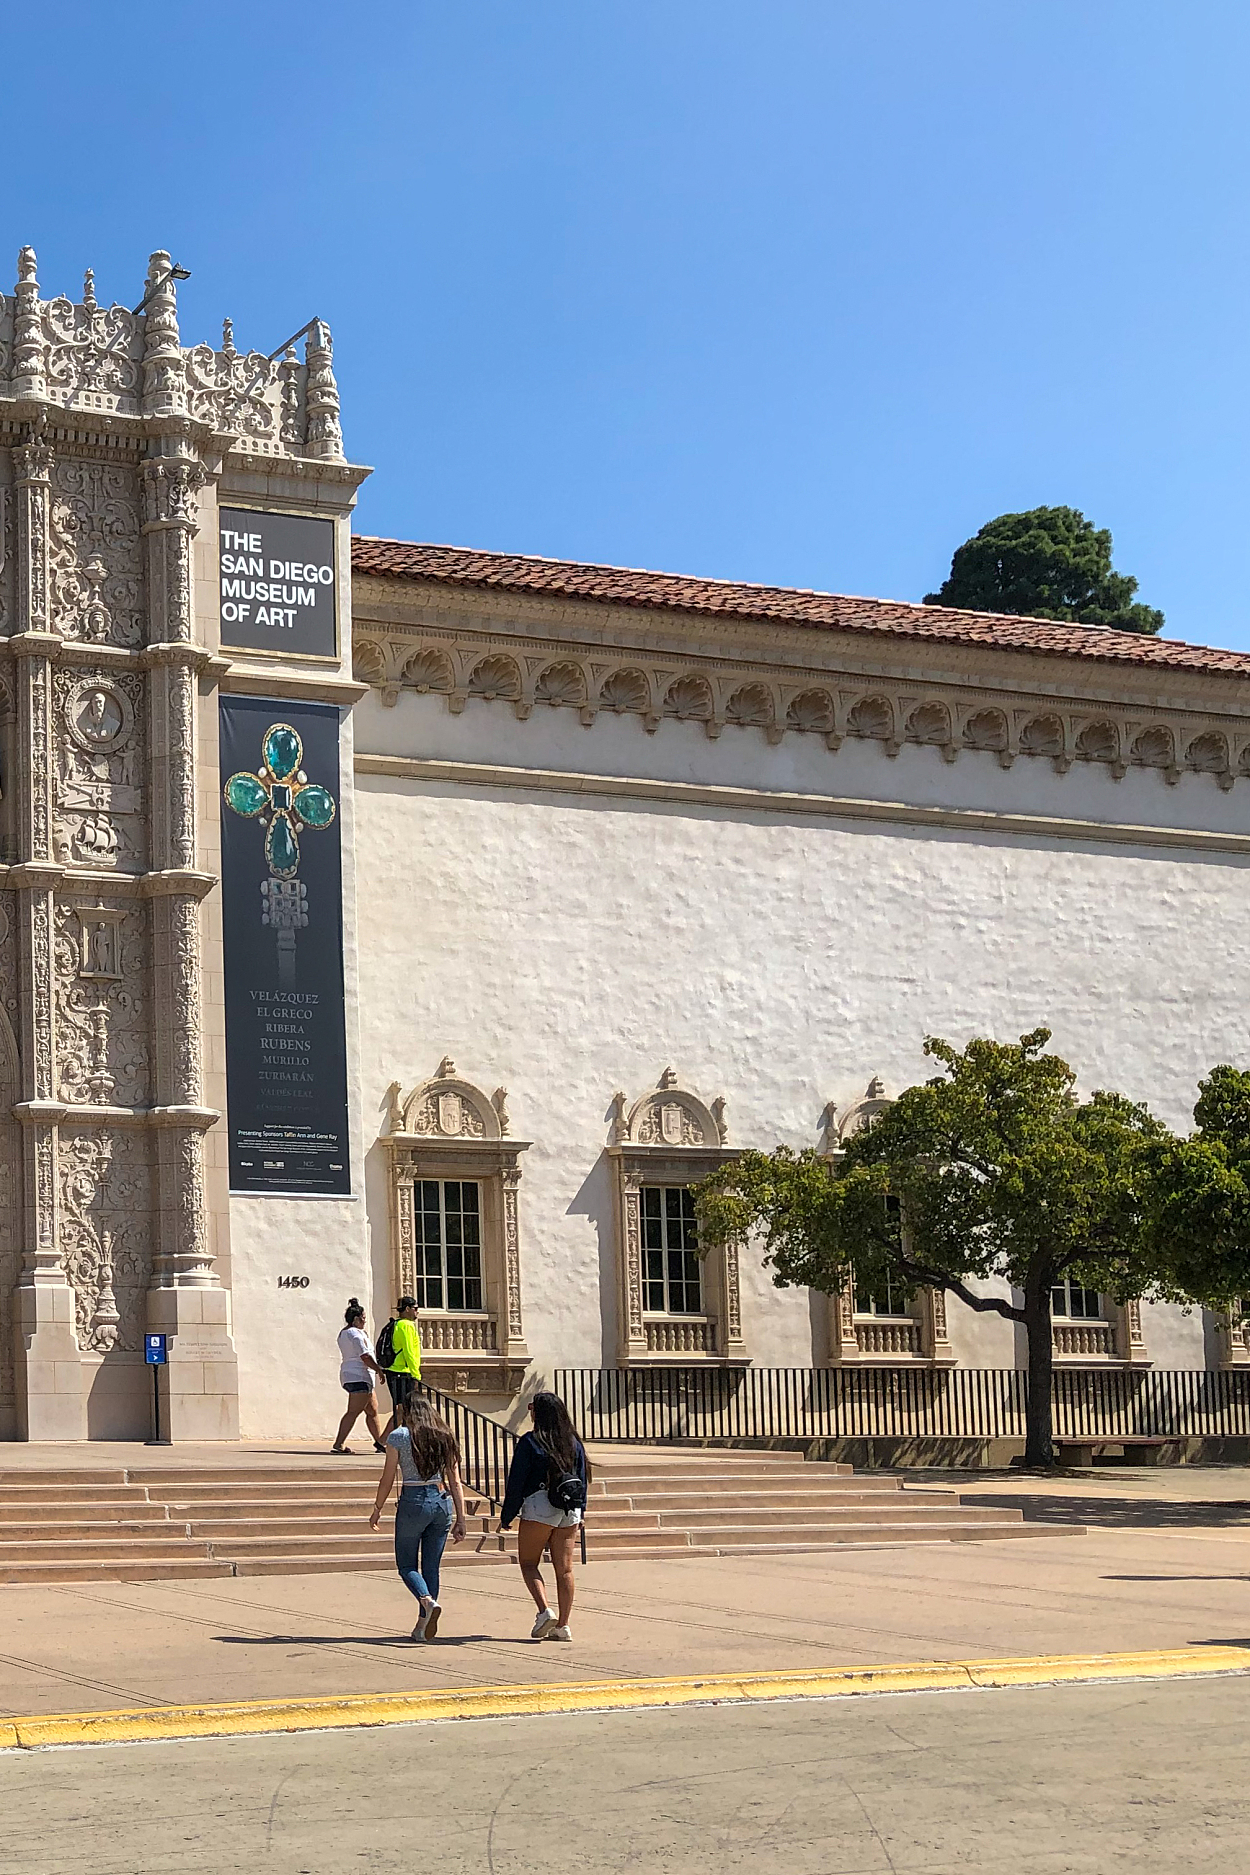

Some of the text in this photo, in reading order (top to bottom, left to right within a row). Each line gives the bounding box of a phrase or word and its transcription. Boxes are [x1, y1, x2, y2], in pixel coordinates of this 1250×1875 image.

[221, 530, 262, 553] THE
[221, 554, 333, 585] SAN DIEGO
[222, 578, 315, 606] MUSEUM
[222, 602, 297, 628] OF ART
[250, 990, 319, 1004] VELÁZQUEZ
[257, 1007, 312, 1019] EL GRECO
[266, 1024, 304, 1033] RIBERA
[260, 1038, 310, 1051] RUBENS
[262, 1056, 309, 1065] MURILLO
[259, 1071, 314, 1081] ZURBARÁN
[277, 1276, 310, 1288] 1450
